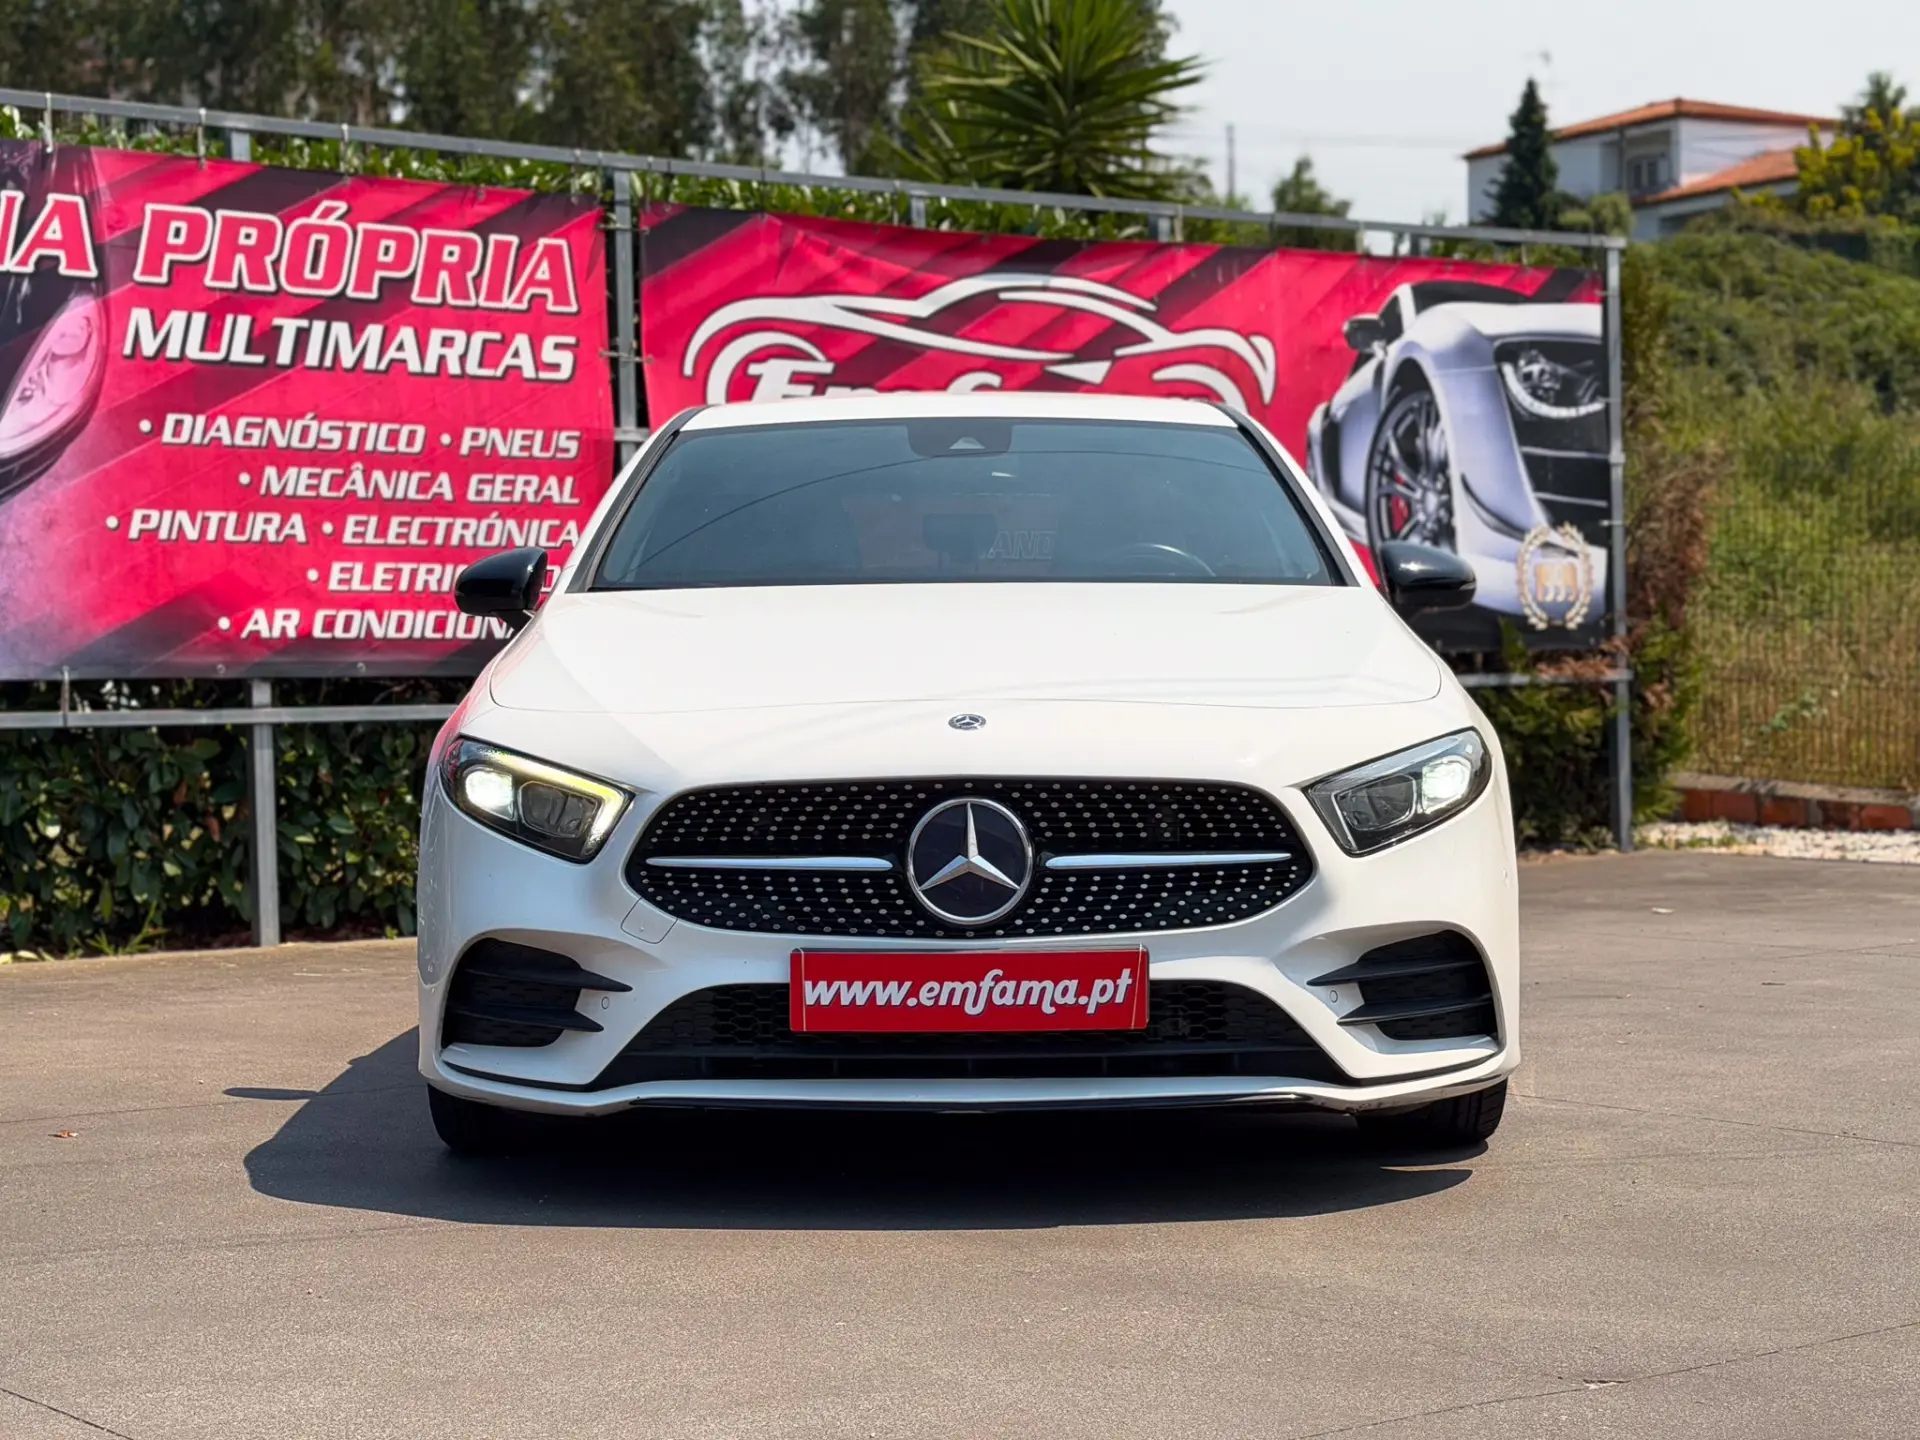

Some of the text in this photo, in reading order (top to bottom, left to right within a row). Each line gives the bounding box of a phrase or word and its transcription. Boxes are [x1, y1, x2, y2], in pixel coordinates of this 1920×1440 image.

[133, 200, 579, 313] PRÓPRIA
[122, 308, 578, 381] MULTIMARCAS
[161, 412, 426, 454] DIAGNÓSTICO
[460, 427, 581, 459] PNEUS
[259, 462, 580, 505] MECÂNICA GERAL
[127, 508, 307, 543] PINTURA
[342, 512, 580, 548] ELECTRÓNICA
[240, 608, 515, 640] AR CONDICION
[803, 968, 1133, 1016] www.emfama.pt
